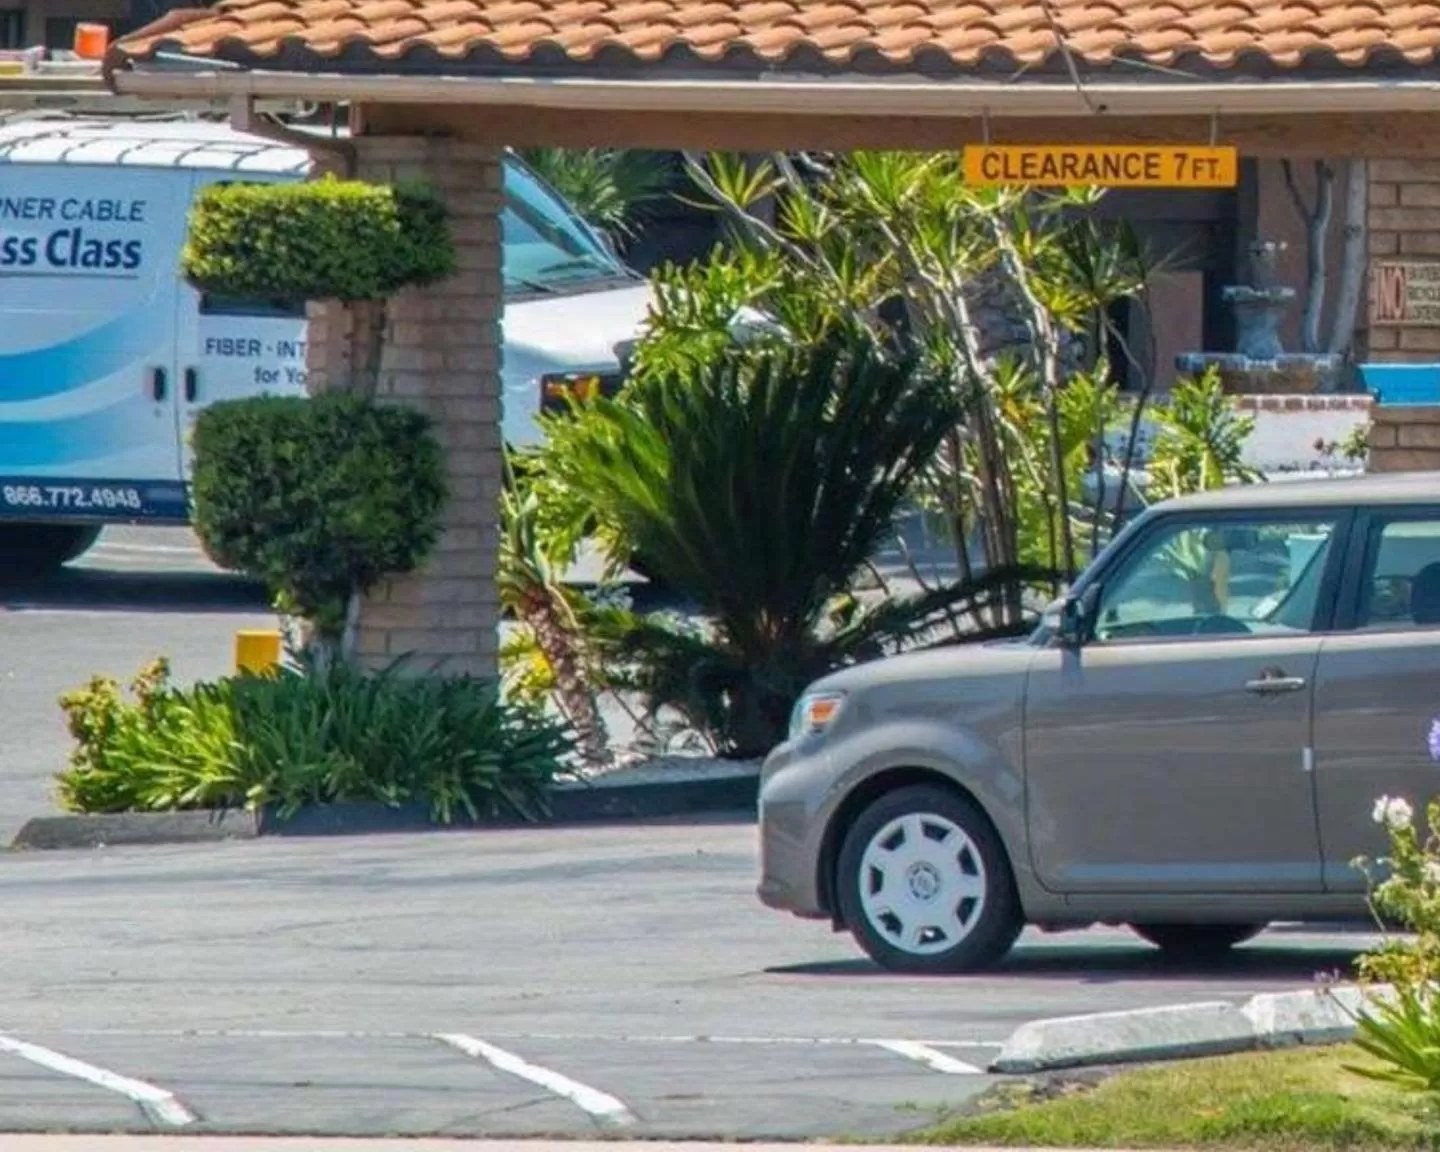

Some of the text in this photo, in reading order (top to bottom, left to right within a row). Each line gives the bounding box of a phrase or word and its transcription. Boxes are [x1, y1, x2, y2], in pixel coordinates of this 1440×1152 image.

[981, 152, 1223, 181] CLEARANCE 7 FT.
[61, 199, 147, 222] CABLE
[46, 227, 142, 269] Class
[1376, 266, 1405, 321] NO
[205, 337, 262, 357] FIBER
[254, 365, 280, 384] for
[3, 485, 142, 508] 866.772.4948
